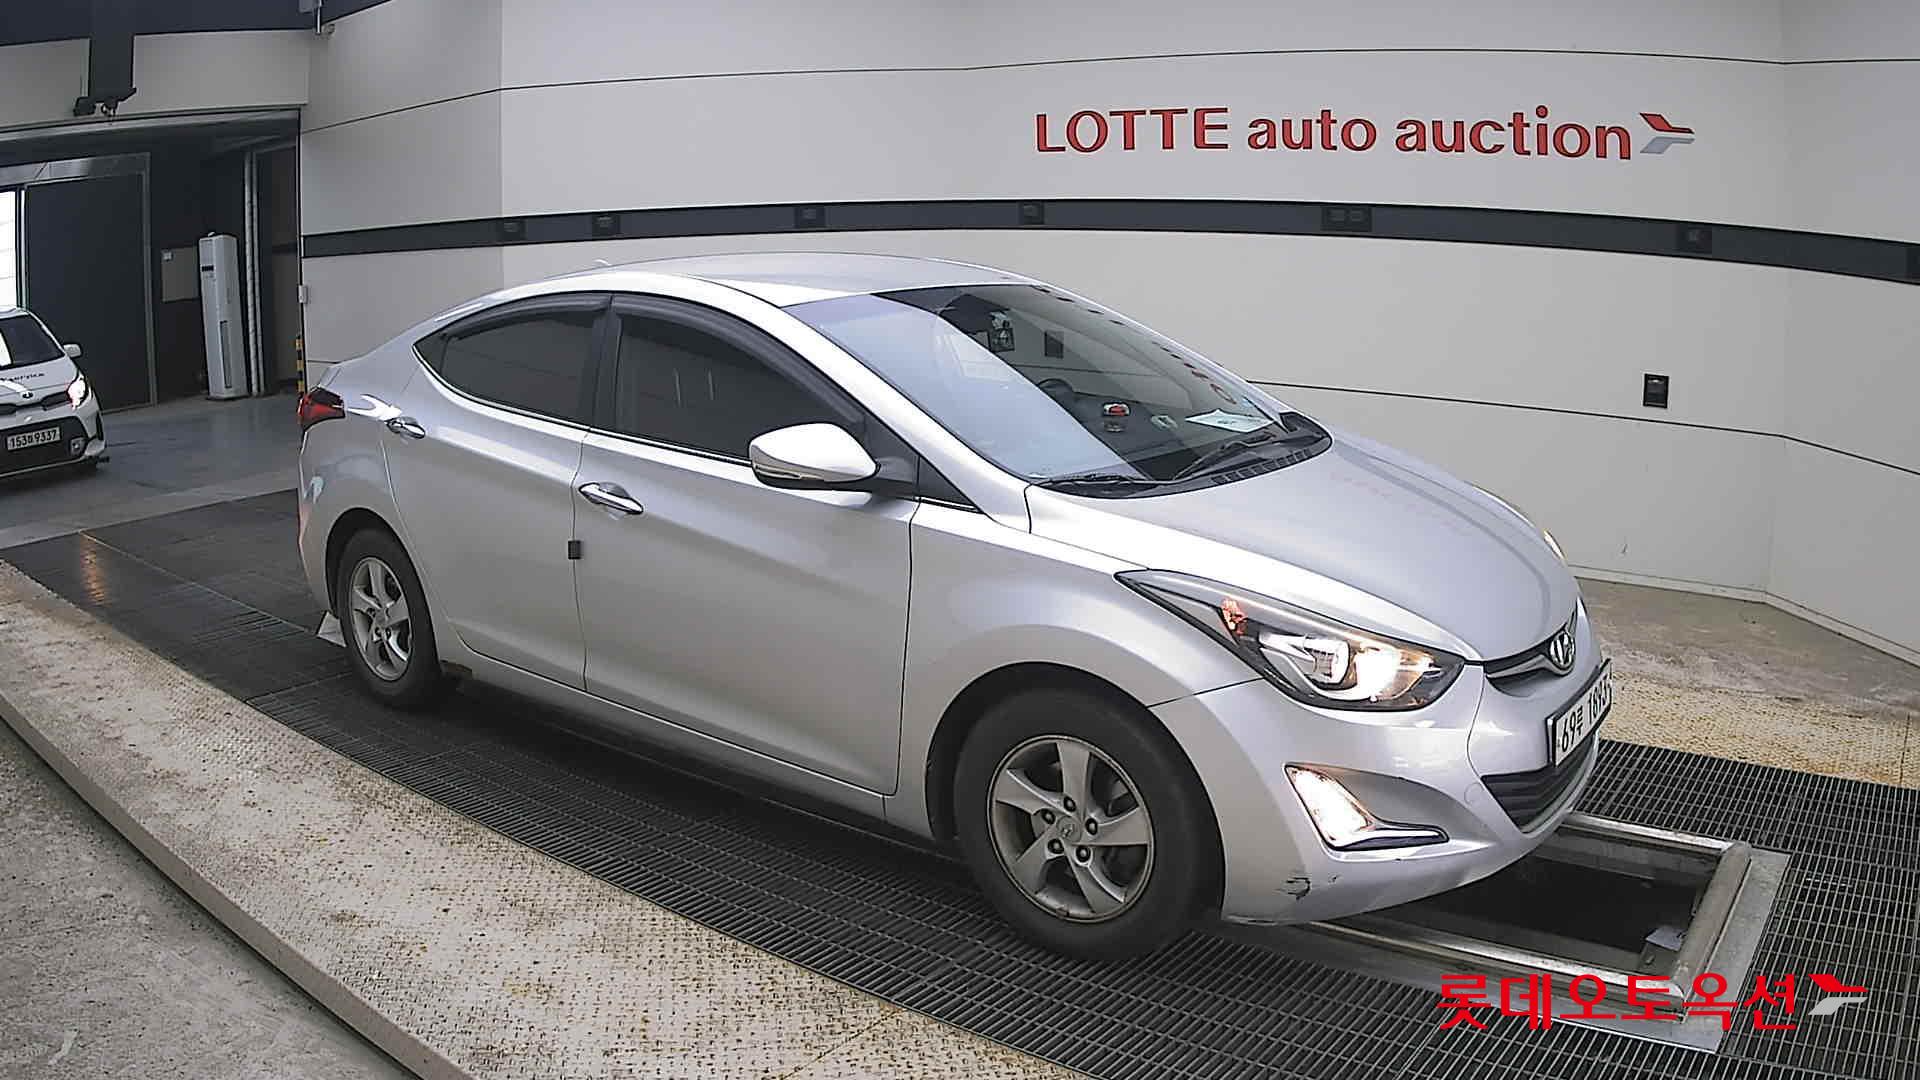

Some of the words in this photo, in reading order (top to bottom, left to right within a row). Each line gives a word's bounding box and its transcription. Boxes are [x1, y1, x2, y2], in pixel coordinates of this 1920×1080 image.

[1036, 107, 1229, 152] LOTTE
[1247, 109, 1377, 151] auto
[1395, 105, 1631, 160] auction
